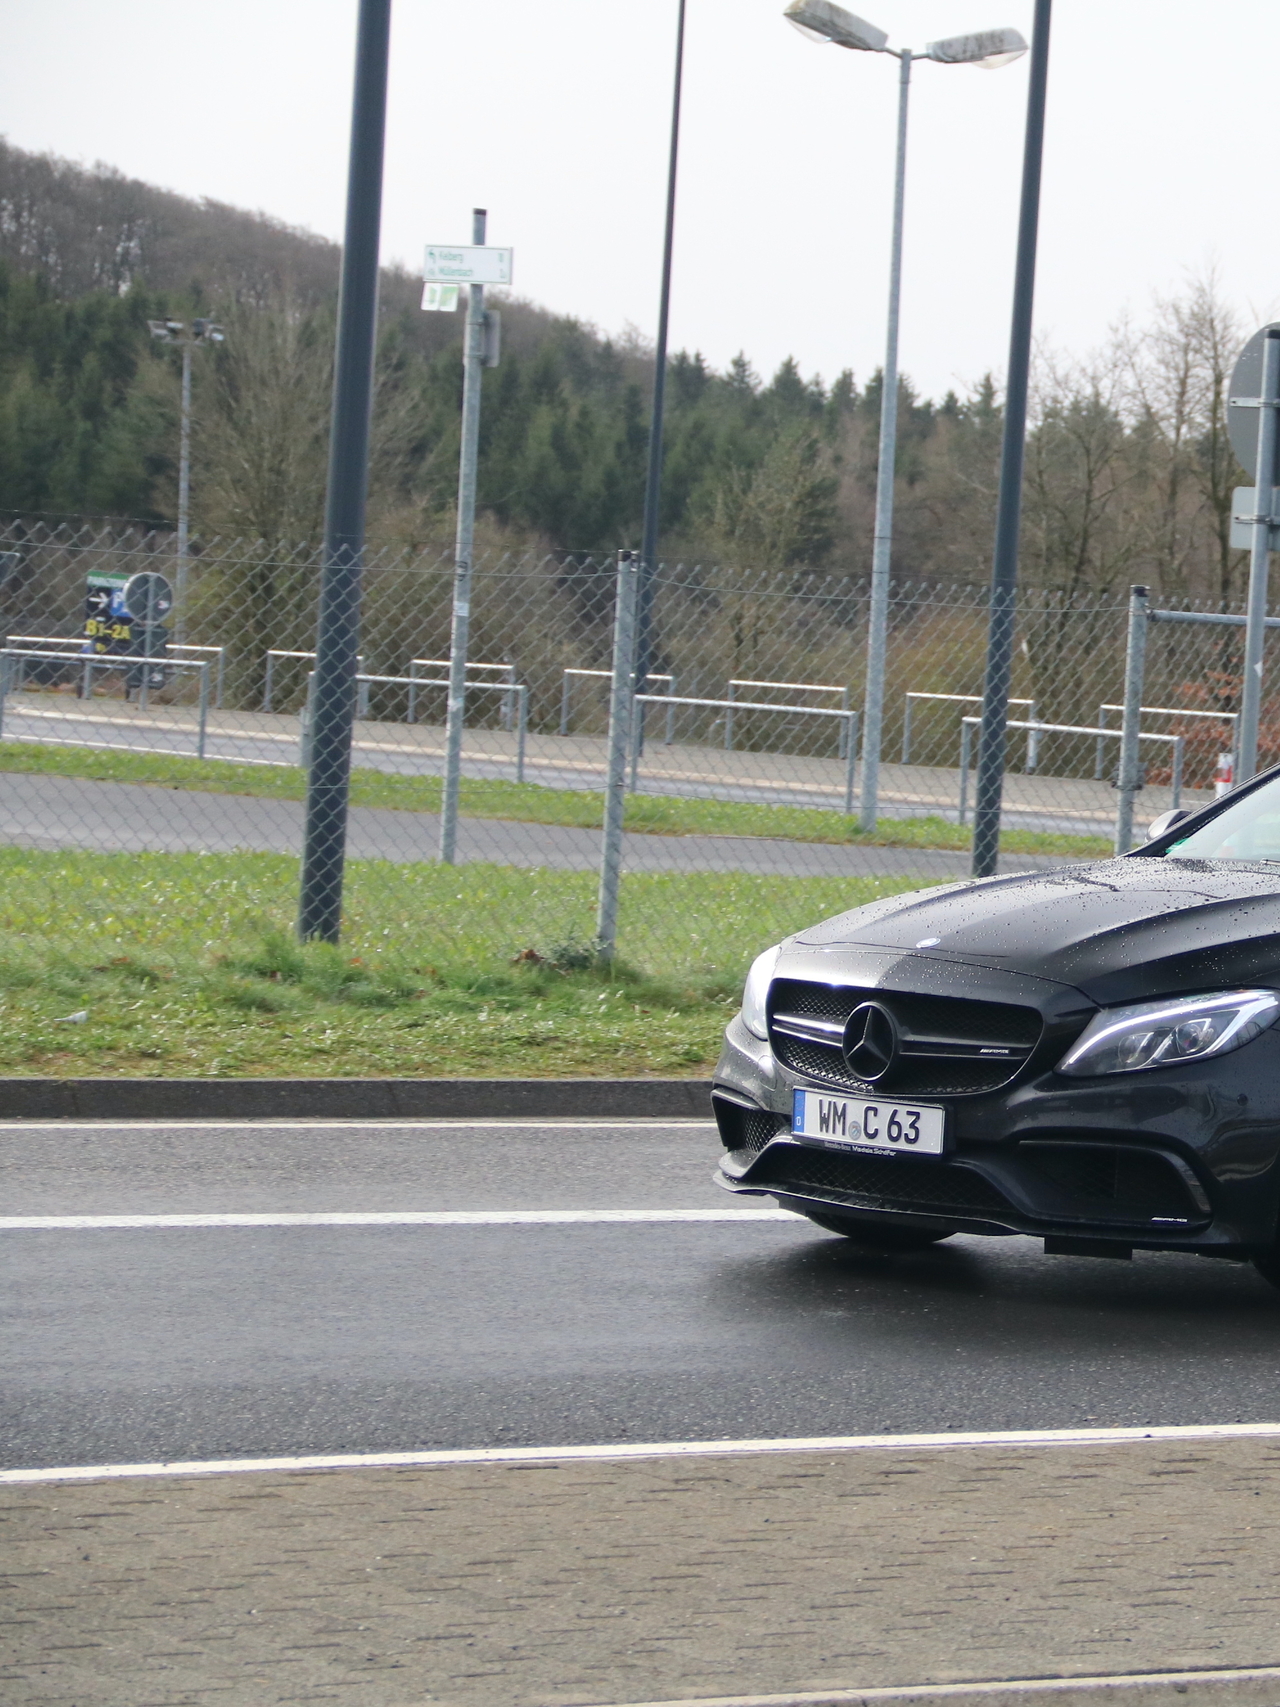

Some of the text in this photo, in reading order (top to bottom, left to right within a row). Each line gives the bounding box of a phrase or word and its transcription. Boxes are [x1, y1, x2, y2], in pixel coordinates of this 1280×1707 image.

[818, 1099, 921, 1145] WM C 63
